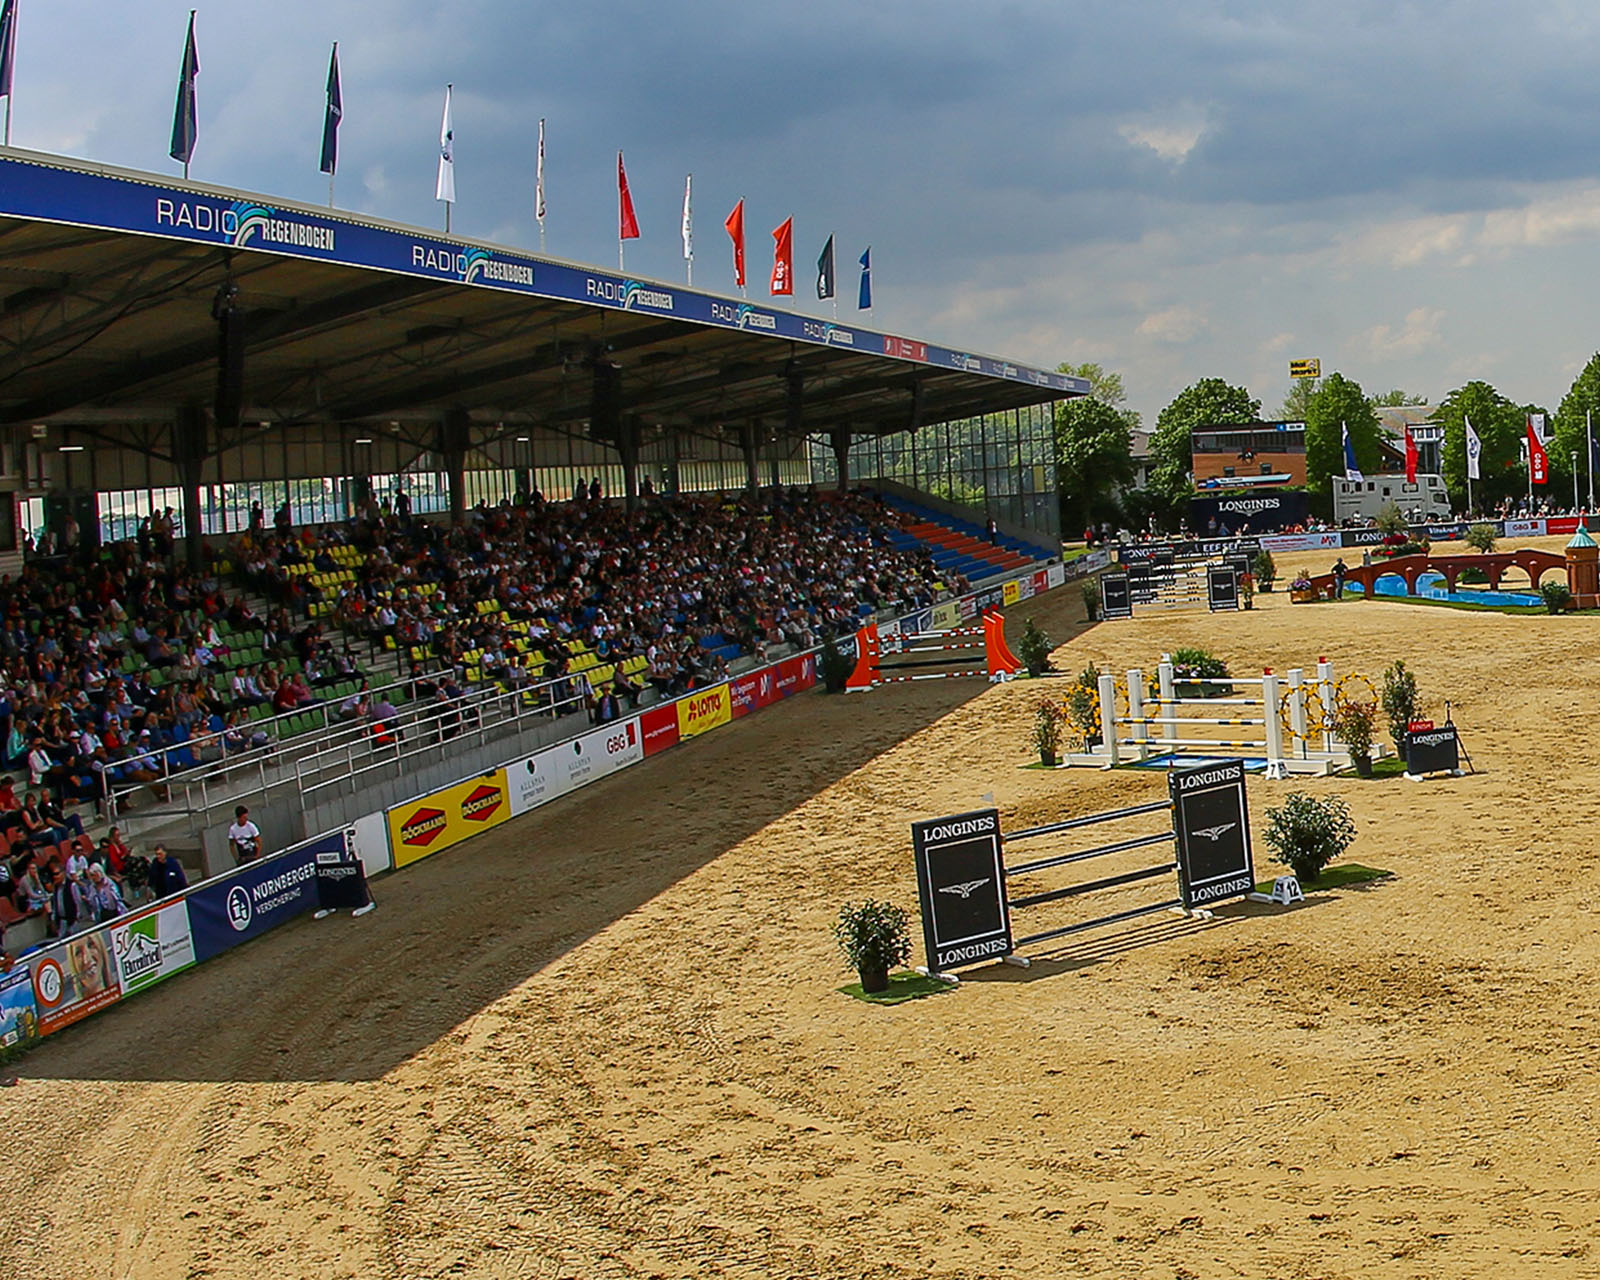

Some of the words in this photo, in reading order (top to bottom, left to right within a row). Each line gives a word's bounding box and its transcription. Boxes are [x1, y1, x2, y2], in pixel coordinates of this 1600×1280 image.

[157, 199, 239, 236] RADIO
[262, 218, 335, 251] REGENBOGEN
[412, 245, 469, 275] RADIO
[483, 261, 534, 286] REGENBOGEN
[586, 279, 627, 302] RADIO
[1218, 498, 1281, 512] LONGINES
[697, 694, 721, 718] LOTTO
[606, 733, 627, 755] GBG
[1412, 731, 1455, 745] LONGINES
[1178, 766, 1242, 790] LONGINES
[922, 816, 996, 843] LONGINES
[318, 866, 358, 878] LONGINES
[1190, 876, 1253, 904] LONGINES
[936, 937, 1009, 967] LONGINES
